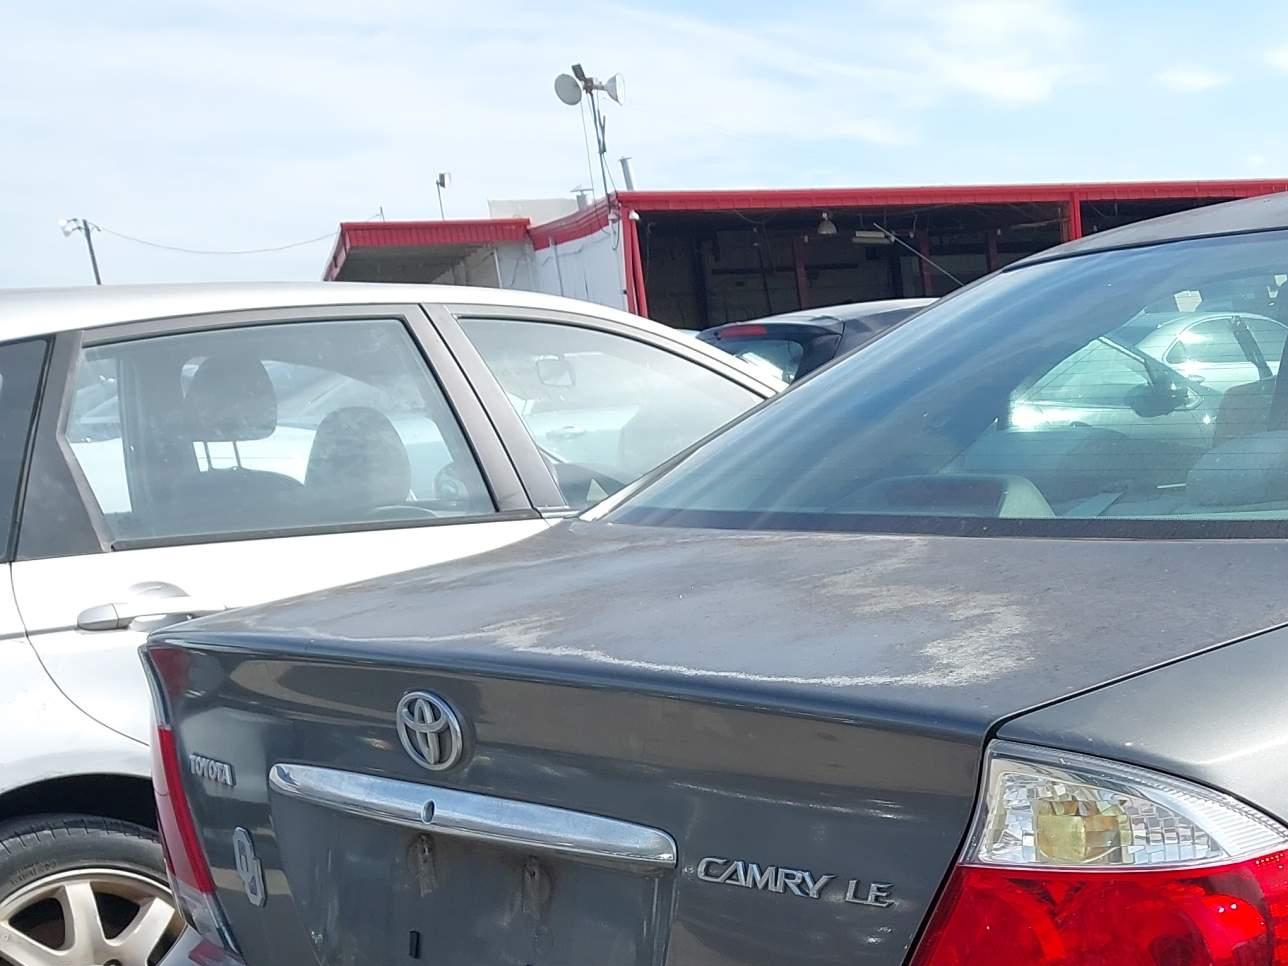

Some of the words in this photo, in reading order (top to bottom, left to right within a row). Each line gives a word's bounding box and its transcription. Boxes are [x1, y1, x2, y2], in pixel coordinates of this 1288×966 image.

[189, 753, 236, 787] TOYOTA
[697, 857, 836, 899] CAMRY
[845, 879, 896, 908] LE
